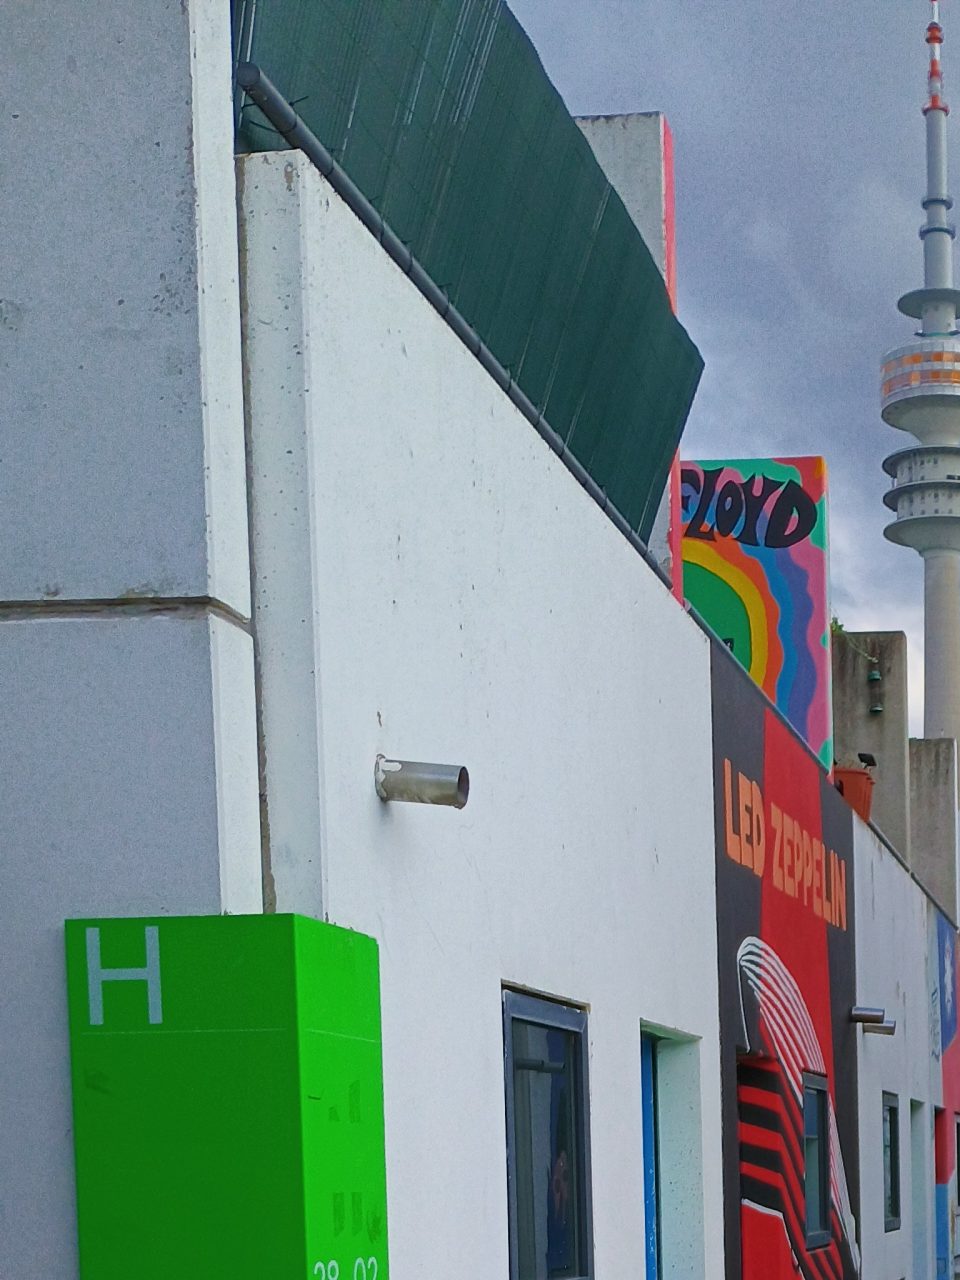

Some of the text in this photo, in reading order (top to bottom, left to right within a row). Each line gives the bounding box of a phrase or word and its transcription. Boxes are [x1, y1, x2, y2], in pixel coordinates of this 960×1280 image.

[724, 758, 847, 932] LED ZEPPELIN
[86, 926, 162, 1025] H
